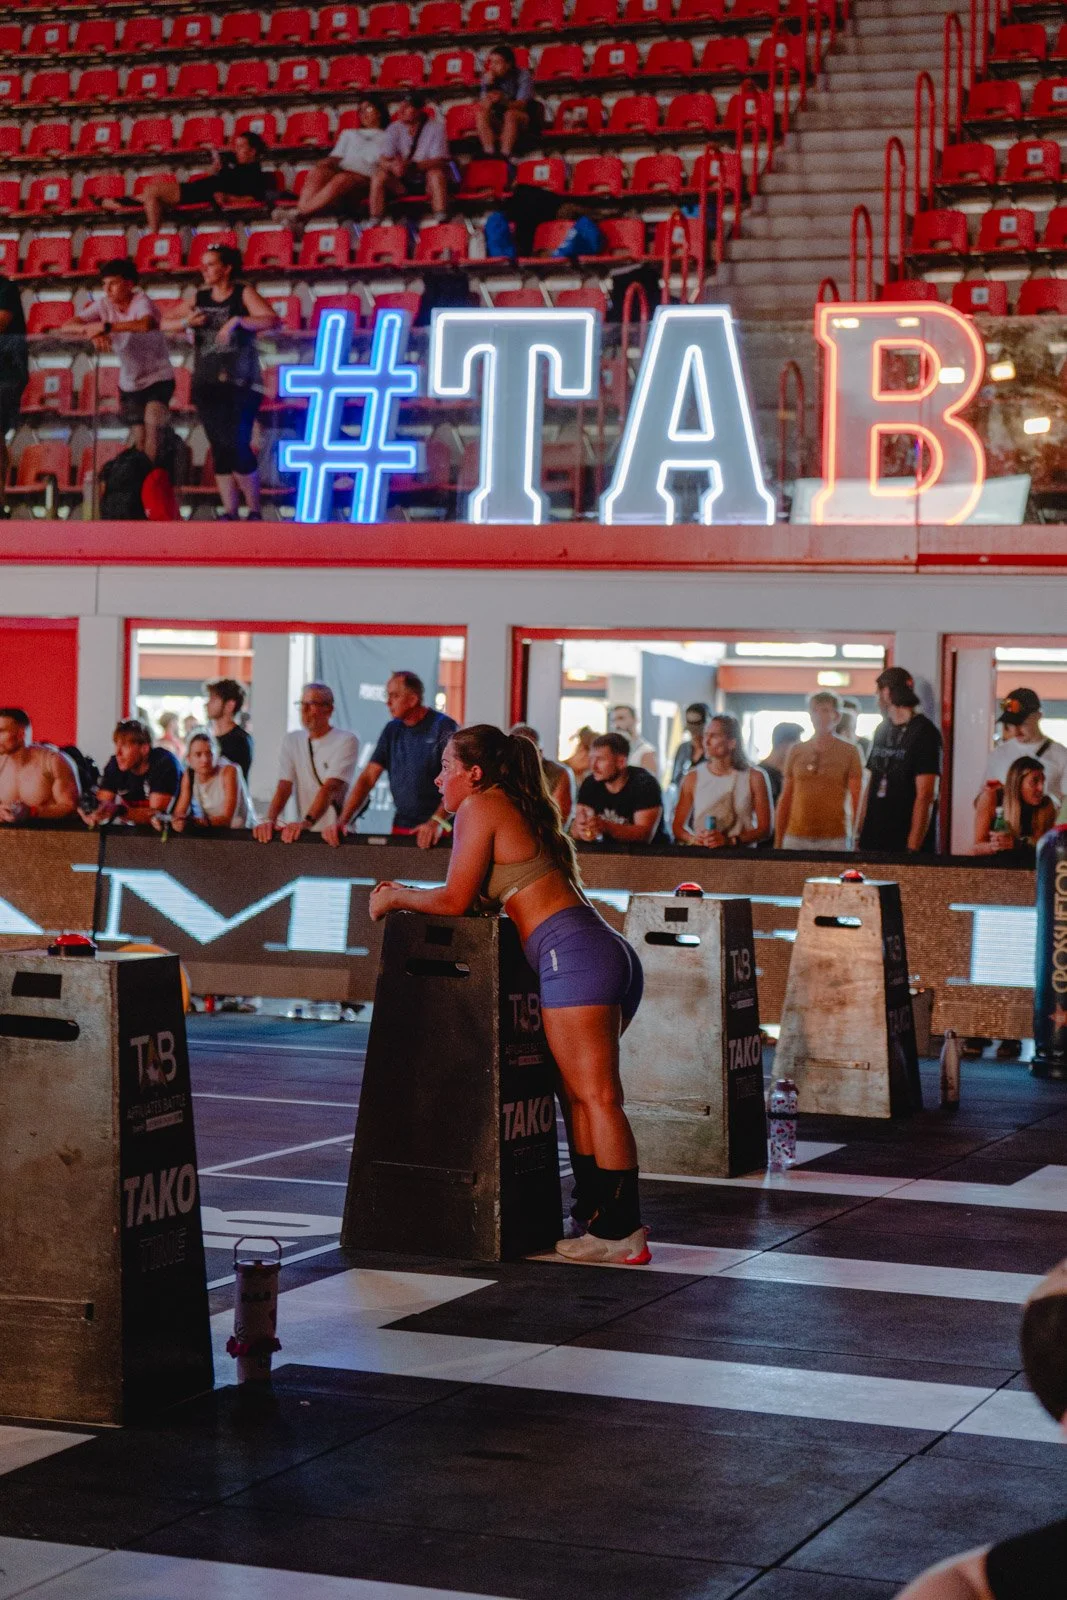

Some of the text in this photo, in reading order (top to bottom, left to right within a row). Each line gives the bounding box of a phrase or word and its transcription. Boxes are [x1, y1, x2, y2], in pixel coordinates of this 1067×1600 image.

[279, 302, 987, 526] #TAB
[728, 1034, 761, 1071] TAKO
[502, 1096, 553, 1141] TAKO
[123, 1163, 197, 1229] TAKO
